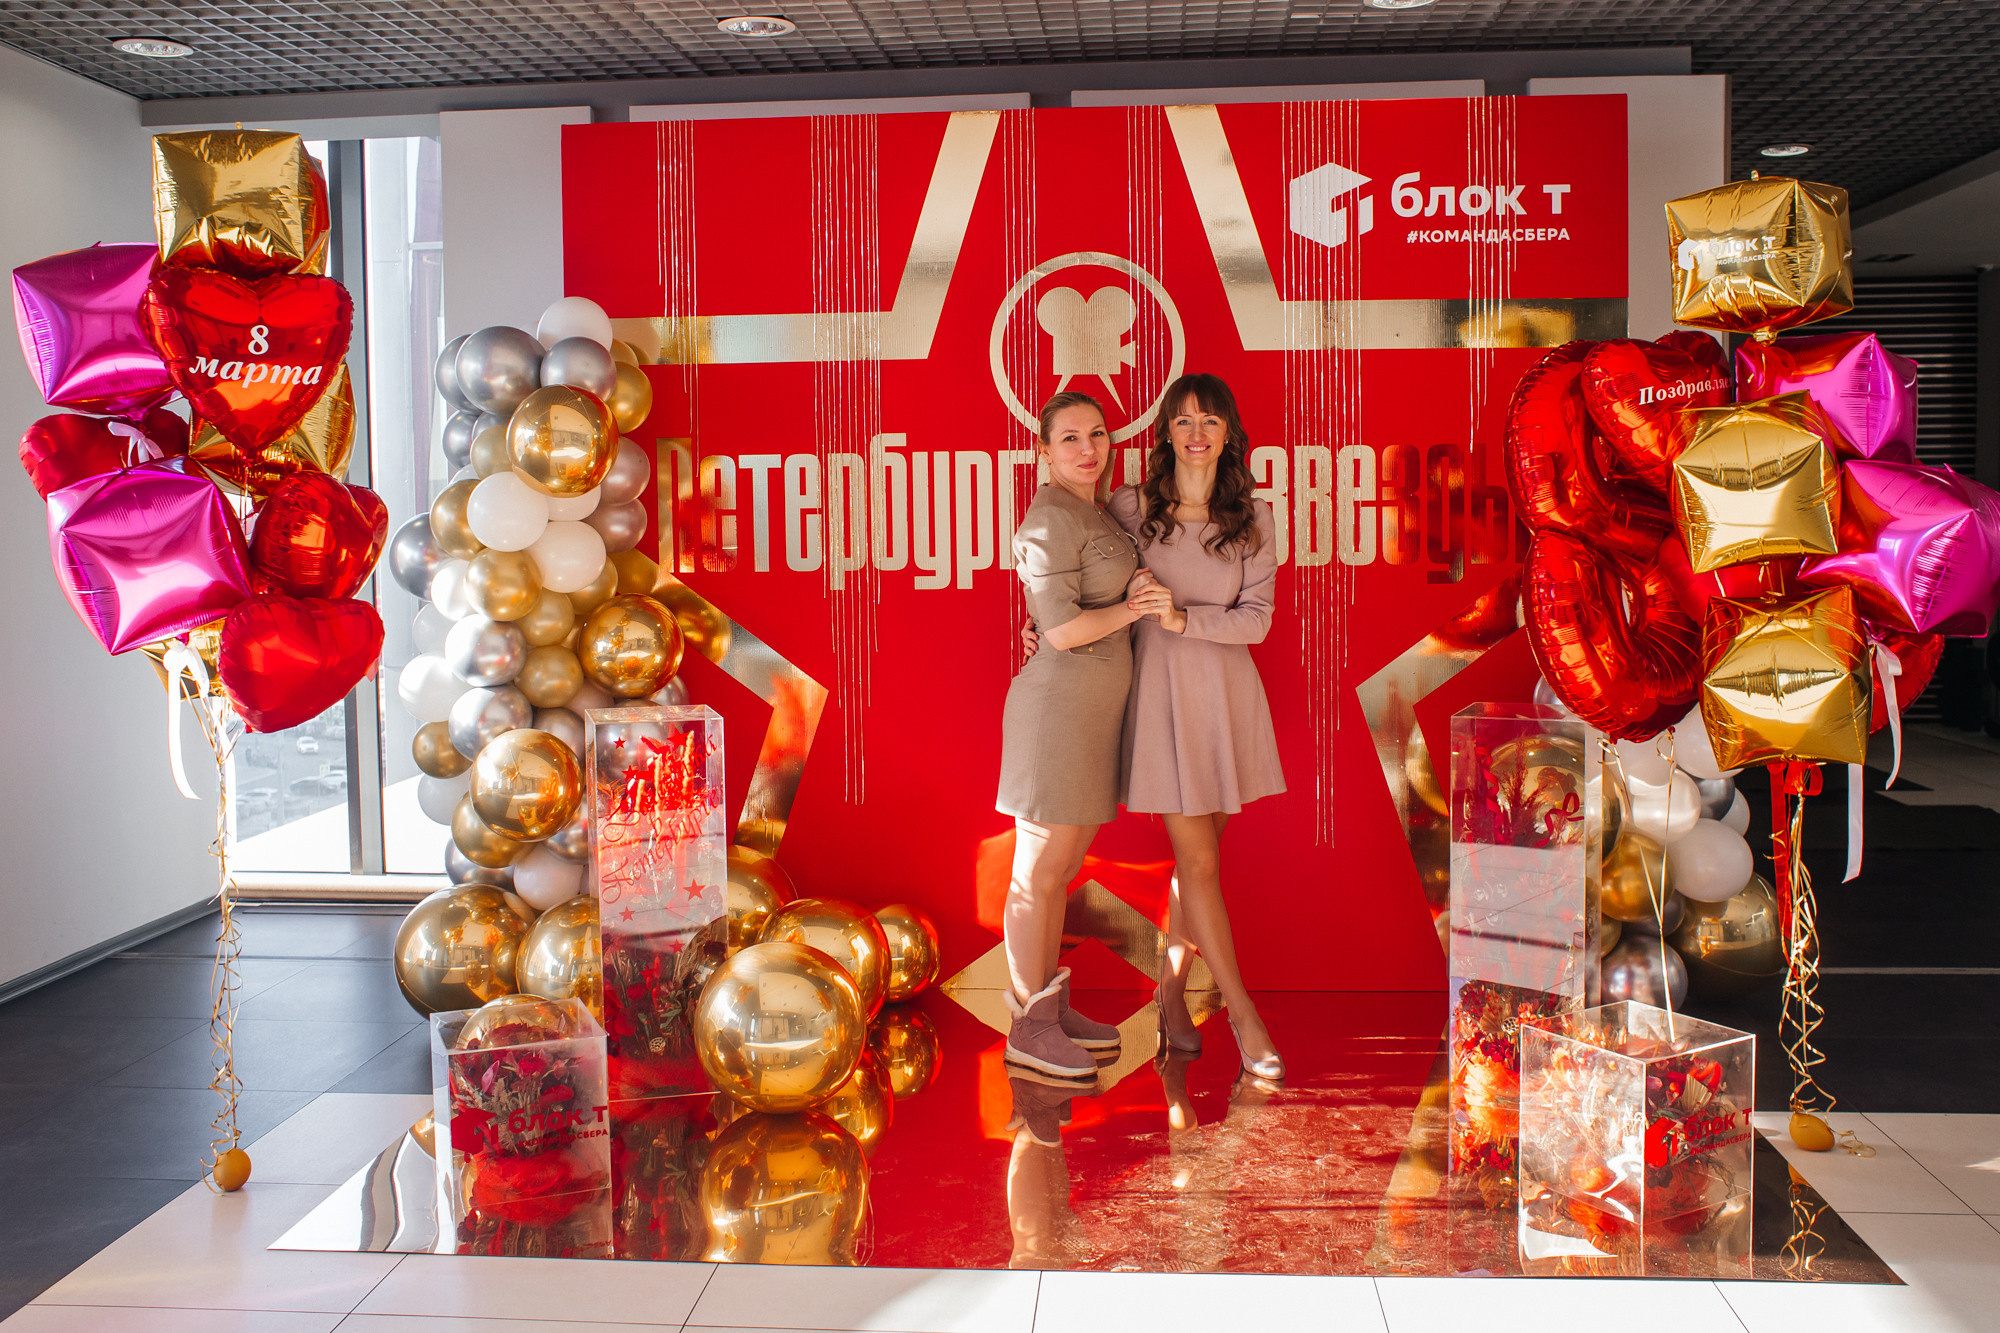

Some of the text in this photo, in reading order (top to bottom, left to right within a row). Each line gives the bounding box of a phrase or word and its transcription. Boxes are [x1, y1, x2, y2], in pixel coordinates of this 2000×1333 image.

[1391, 171, 1571, 217] блок т
[1406, 228, 1570, 244] #КОМАНДАСБЕРА
[248, 325, 269, 355] 8
[189, 356, 323, 388] марта
[1638, 378, 1732, 406] Поздравляе
[508, 1108, 584, 1134] блок
[1684, 1112, 1736, 1142] блок
